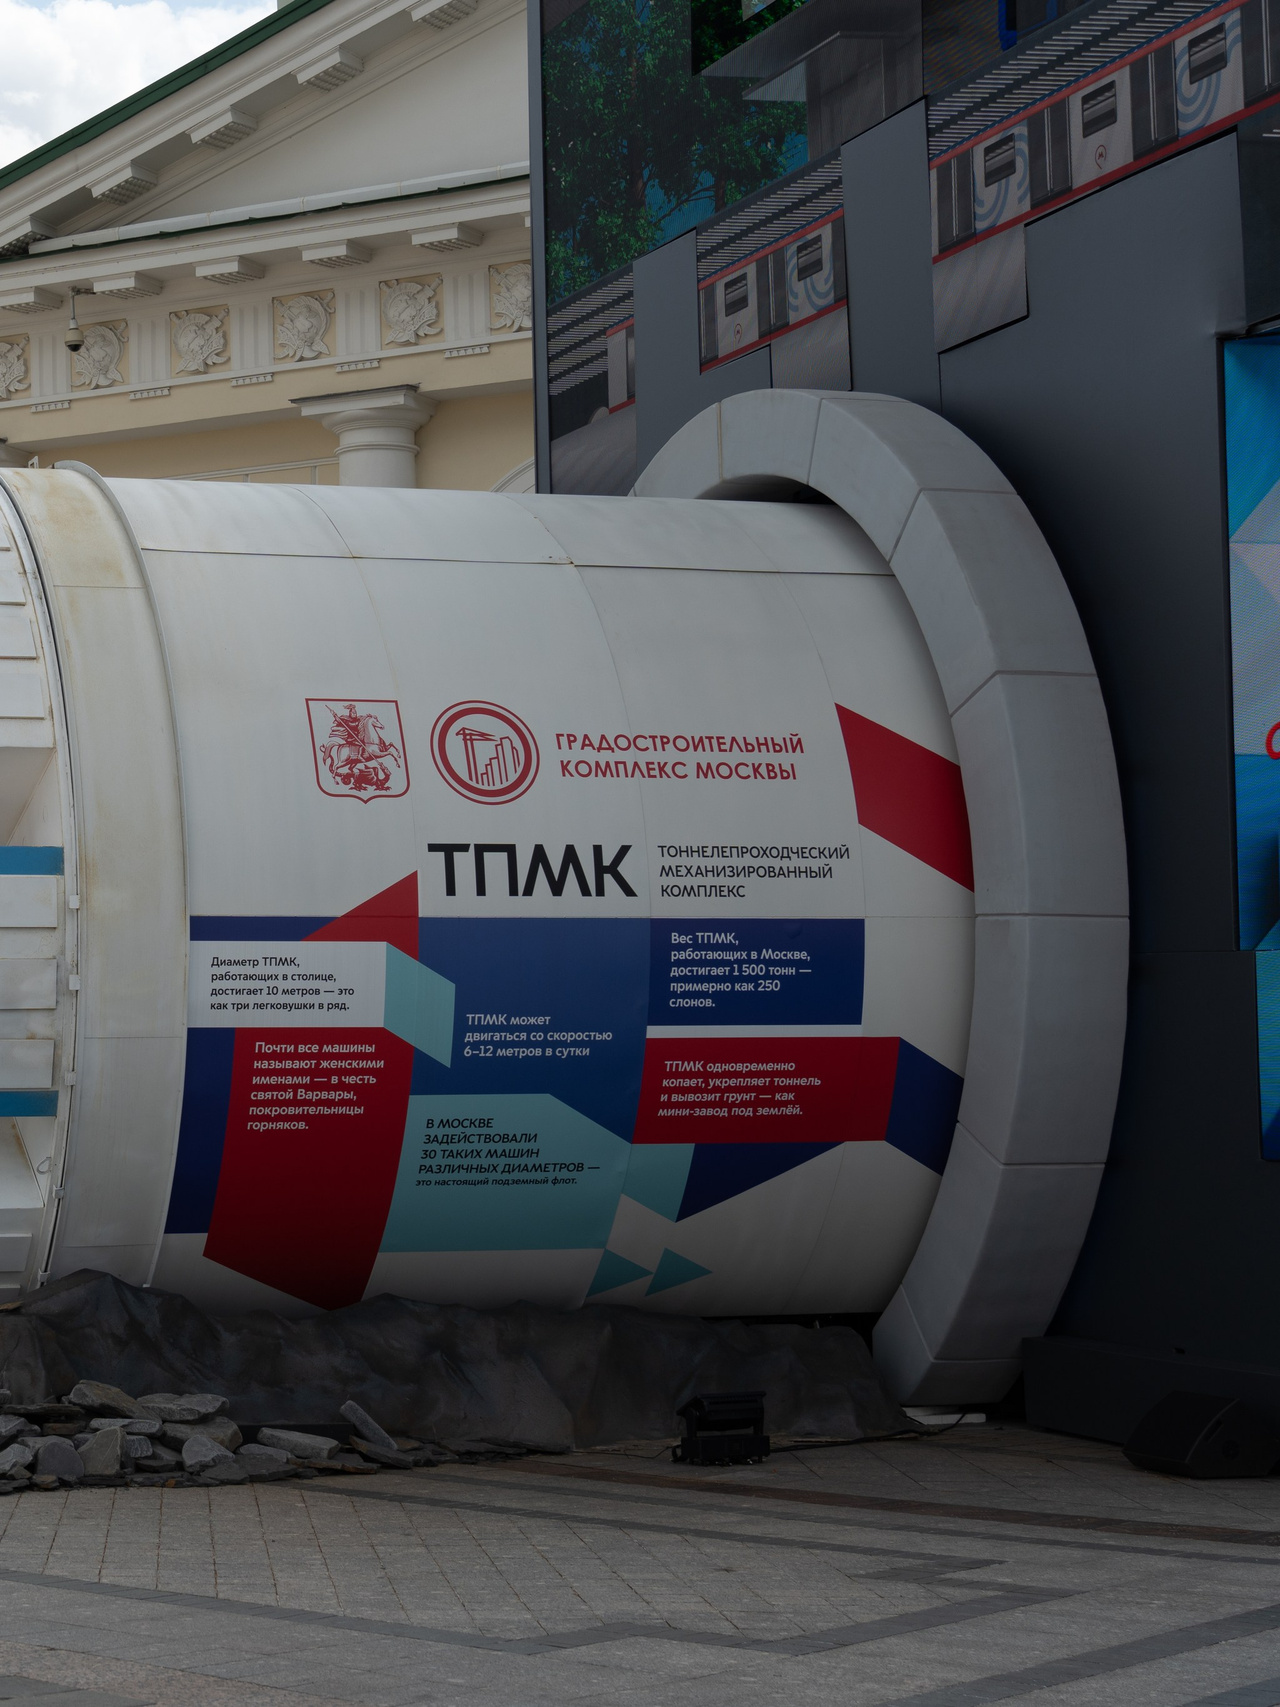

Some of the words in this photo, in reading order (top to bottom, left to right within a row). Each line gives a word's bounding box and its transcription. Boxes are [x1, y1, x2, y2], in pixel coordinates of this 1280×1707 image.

[555, 733, 805, 754] ГРАДОСТРОИТЕЛЬНЫЙ
[560, 760, 689, 779] КОМПЛЕКС
[696, 762, 797, 780] МОСКВЫ
[658, 844, 850, 861] ТОННЕЛЕПРОХОДЧЕСКИЙ
[427, 843, 638, 897] ТПМК
[659, 863, 833, 879] МЕХАНИЗИРОВАННЫЙ
[660, 885, 746, 898] КОМПЛЕКС
[671, 933, 693, 944] Вес
[696, 933, 739, 945] ТПМК,
[671, 949, 747, 962] работающих
[751, 951, 757, 960] в
[761, 949, 811, 961] Москве,
[211, 957, 259, 968] Диаметр
[262, 957, 300, 968] ТПМК,
[211, 971, 279, 983] работающих
[282, 973, 288, 981] в
[291, 973, 336, 983] столице,
[670, 966, 730, 977] достигает
[768, 967, 796, 975] тонн
[210, 988, 264, 997] достигает
[266, 986, 279, 995] 10
[281, 988, 321, 997] метров
[338, 988, 355, 996] это
[670, 982, 732, 994] примерно
[735, 982, 755, 991] как
[757, 980, 781, 991] 250
[210, 1002, 228, 1010] как
[231, 1002, 250, 1012] три
[252, 1002, 315, 1012] легковушки
[318, 1002, 324, 1010] в
[327, 1002, 350, 1012] ряд.
[669, 998, 716, 1007] слонов.
[466, 1014, 507, 1025] ТПМК
[510, 1016, 551, 1025] может
[465, 1032, 527, 1043] двигаться
[530, 1032, 544, 1041] со
[547, 1032, 612, 1043] скоростью
[255, 1042, 295, 1053] Почти
[298, 1044, 319, 1053] все
[322, 1044, 376, 1053] машины
[496, 1048, 542, 1059] метров
[545, 1048, 552, 1056] в
[555, 1047, 590, 1058] сутки
[254, 1060, 317, 1069] называют
[319, 1060, 385, 1068] женскими
[665, 1061, 704, 1072] ТПМК
[706, 1062, 796, 1073] одновременно
[252, 1076, 310, 1084] именами
[331, 1076, 338, 1084] в
[342, 1075, 377, 1084] честь
[662, 1078, 705, 1088] копает,
[708, 1077, 771, 1089] укрепляет
[774, 1077, 821, 1086] тоннель
[251, 1089, 293, 1100] святой
[297, 1088, 357, 1101] Варвары,
[660, 1093, 668, 1102] и
[671, 1093, 721, 1102] вывозит
[723, 1092, 756, 1103] грунт
[775, 1092, 795, 1101] как
[249, 1105, 364, 1117] покровительницы
[658, 1107, 728, 1117] мини-завод
[731, 1106, 753, 1117] под
[756, 1105, 803, 1116] землёй.
[247, 1121, 309, 1132] горняков.
[426, 1119, 435, 1128] В
[437, 1118, 494, 1128] МОСКВЕ
[423, 1132, 538, 1146] ЗАДЕЙСТВОВАЛИ
[421, 1150, 436, 1159] 30
[440, 1149, 483, 1159] ТАКИХ
[485, 1148, 540, 1159] МАШИН
[418, 1163, 499, 1174] РАЗЛИЧНЫХ
[501, 1162, 584, 1175] ДИАМЕТРОВ
[416, 1179, 432, 1187] это
[434, 1178, 489, 1187] настоящий
[491, 1177, 549, 1187] подземный
[551, 1176, 578, 1186] флот.
